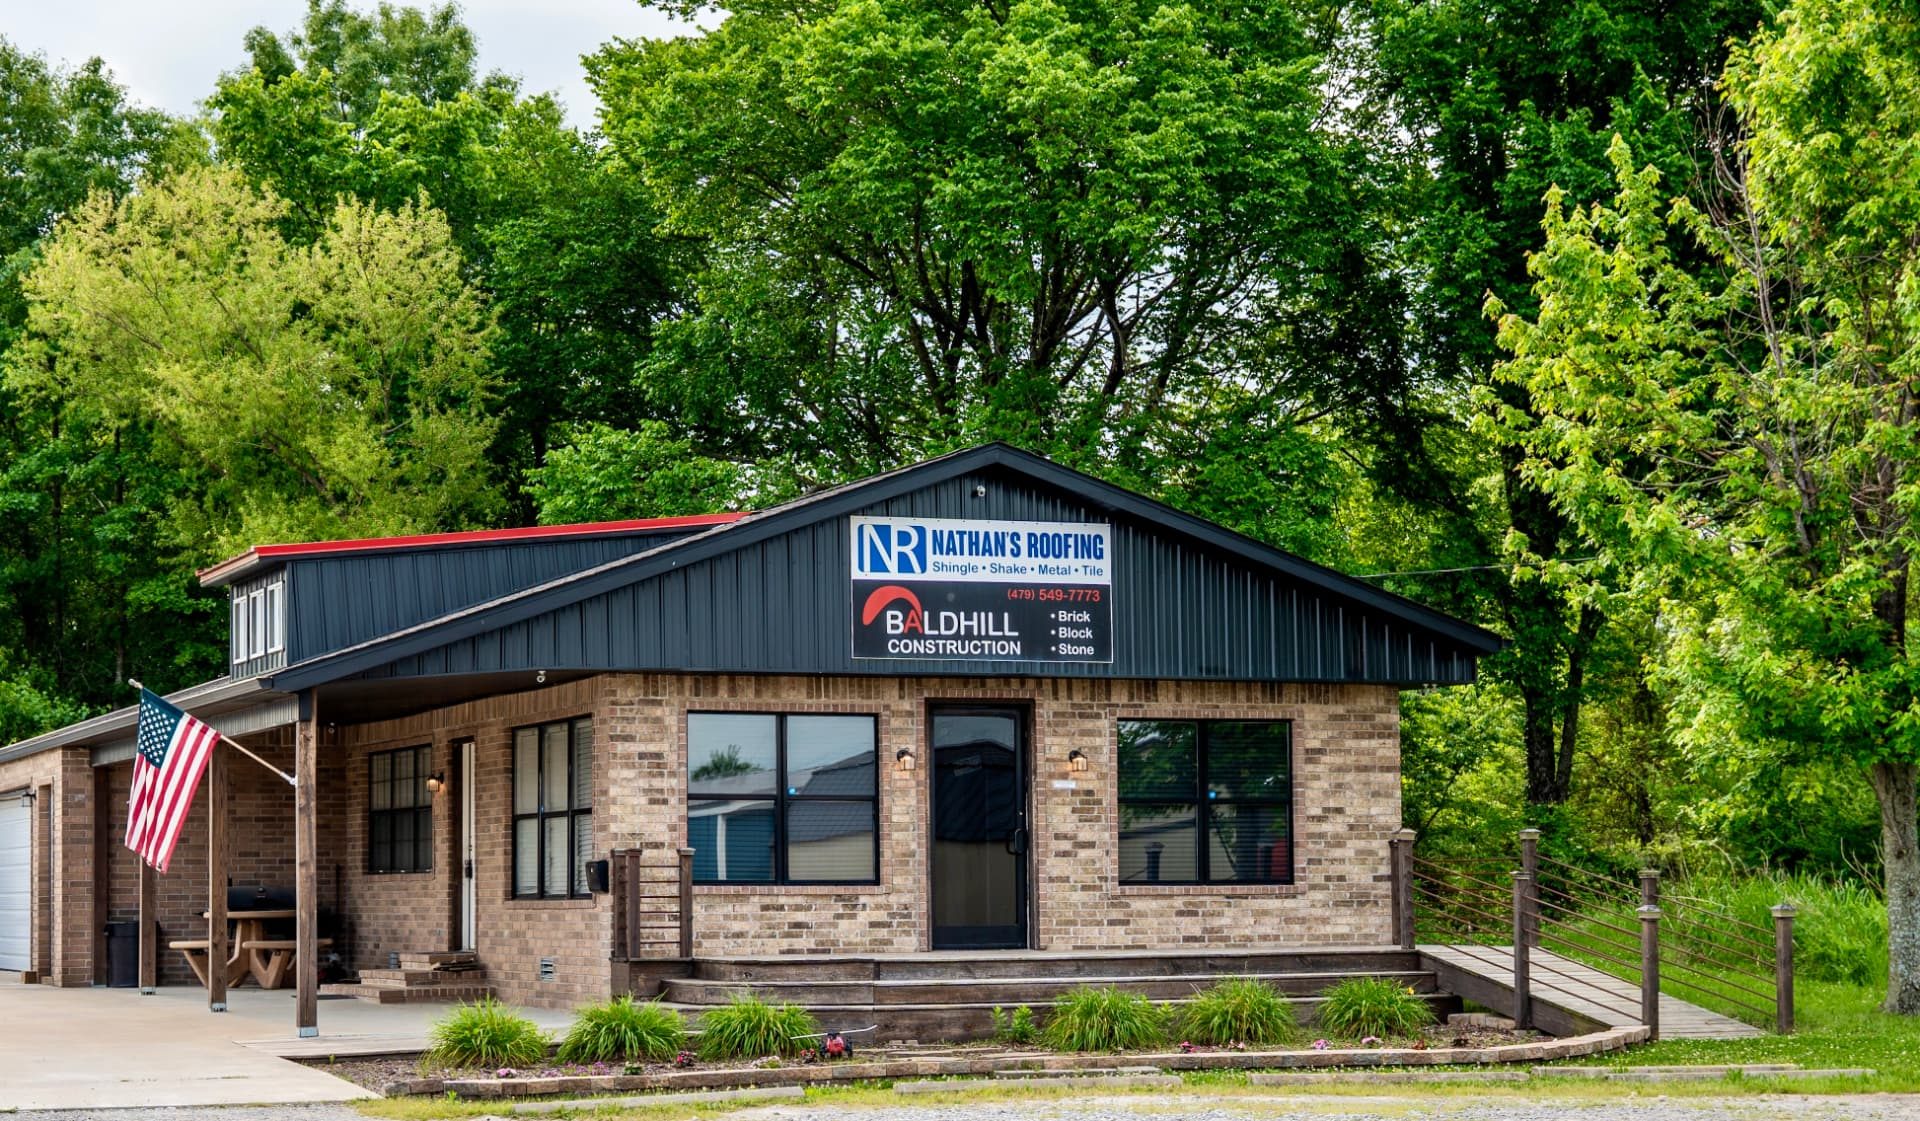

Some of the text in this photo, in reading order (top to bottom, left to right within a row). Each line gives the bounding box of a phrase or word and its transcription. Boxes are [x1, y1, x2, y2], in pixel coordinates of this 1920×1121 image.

[932, 529, 1104, 560] NATHAN'S ROOFING
[932, 561, 1104, 577] Shingle Shake Metal Tile
[1007, 589, 1101, 602] (479) 549-7773
[886, 610, 1019, 636] BALDHILL
[1058, 611, 1091, 623] Brick
[1058, 627, 1093, 639] Block
[888, 639, 1021, 656] CONSTRUCTION
[1058, 644, 1094, 656] Stone
